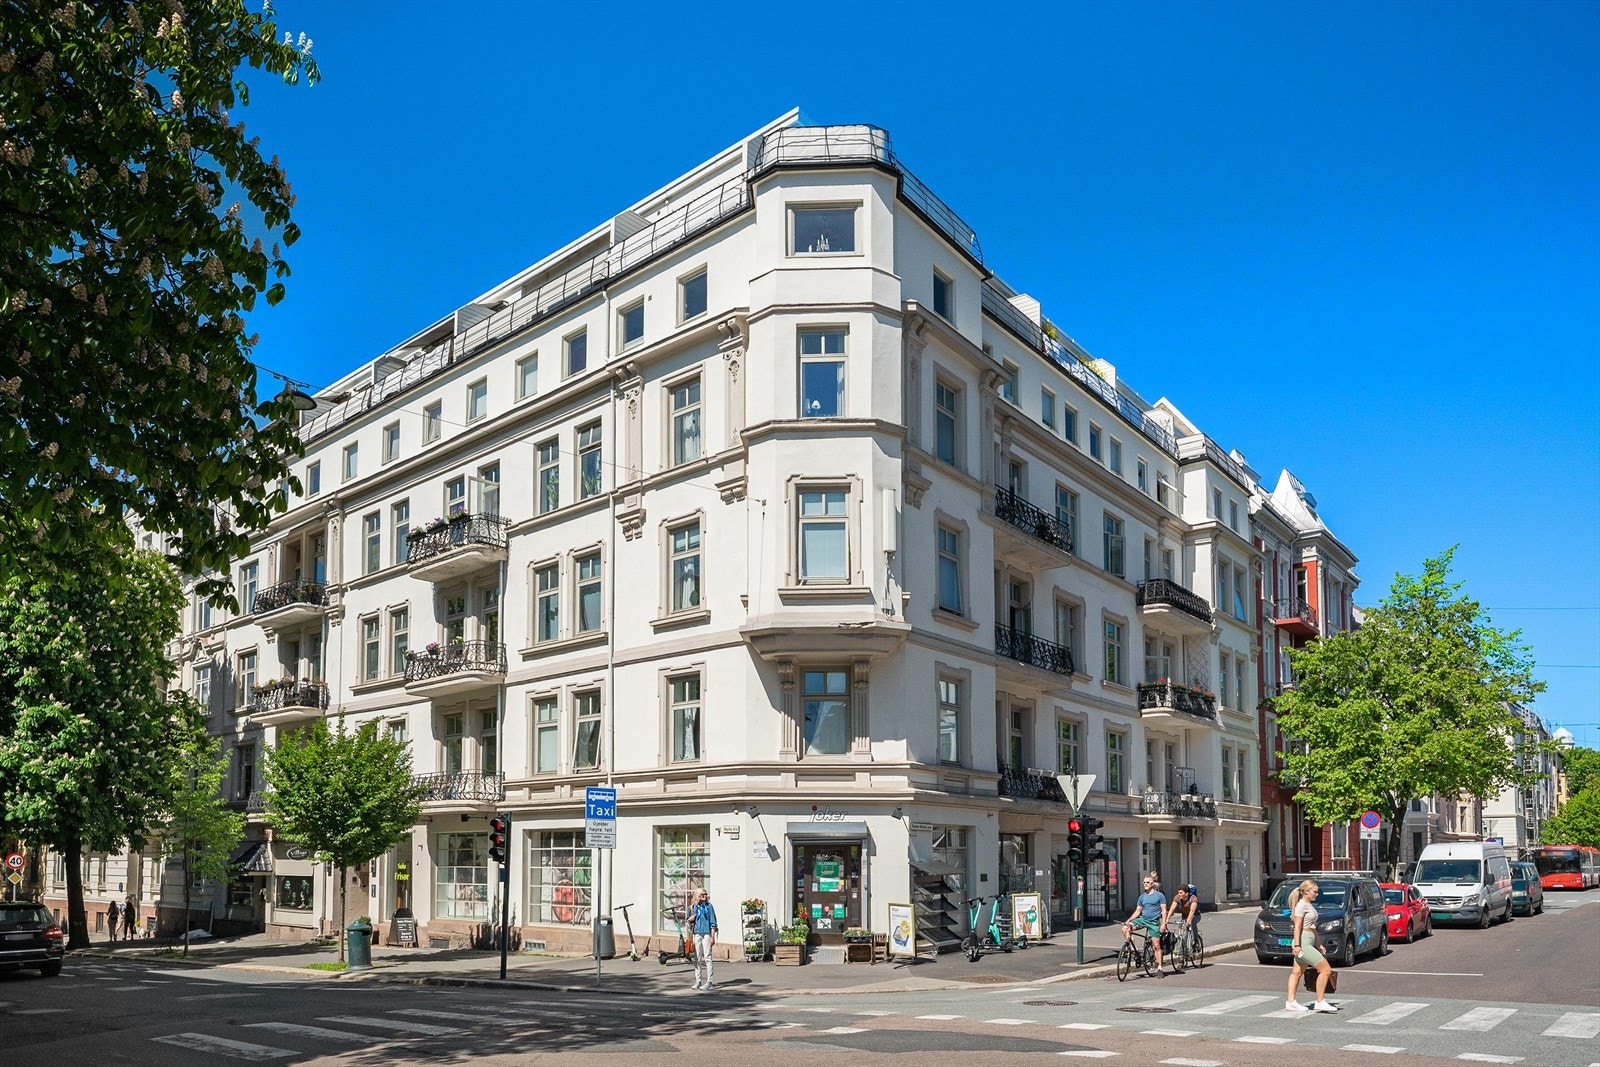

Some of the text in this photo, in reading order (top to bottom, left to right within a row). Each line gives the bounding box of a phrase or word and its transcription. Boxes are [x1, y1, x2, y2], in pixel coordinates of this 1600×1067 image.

[588, 804, 614, 816] Taxi
[809, 805, 848, 822] joker
[10, 857, 22, 865] 40
